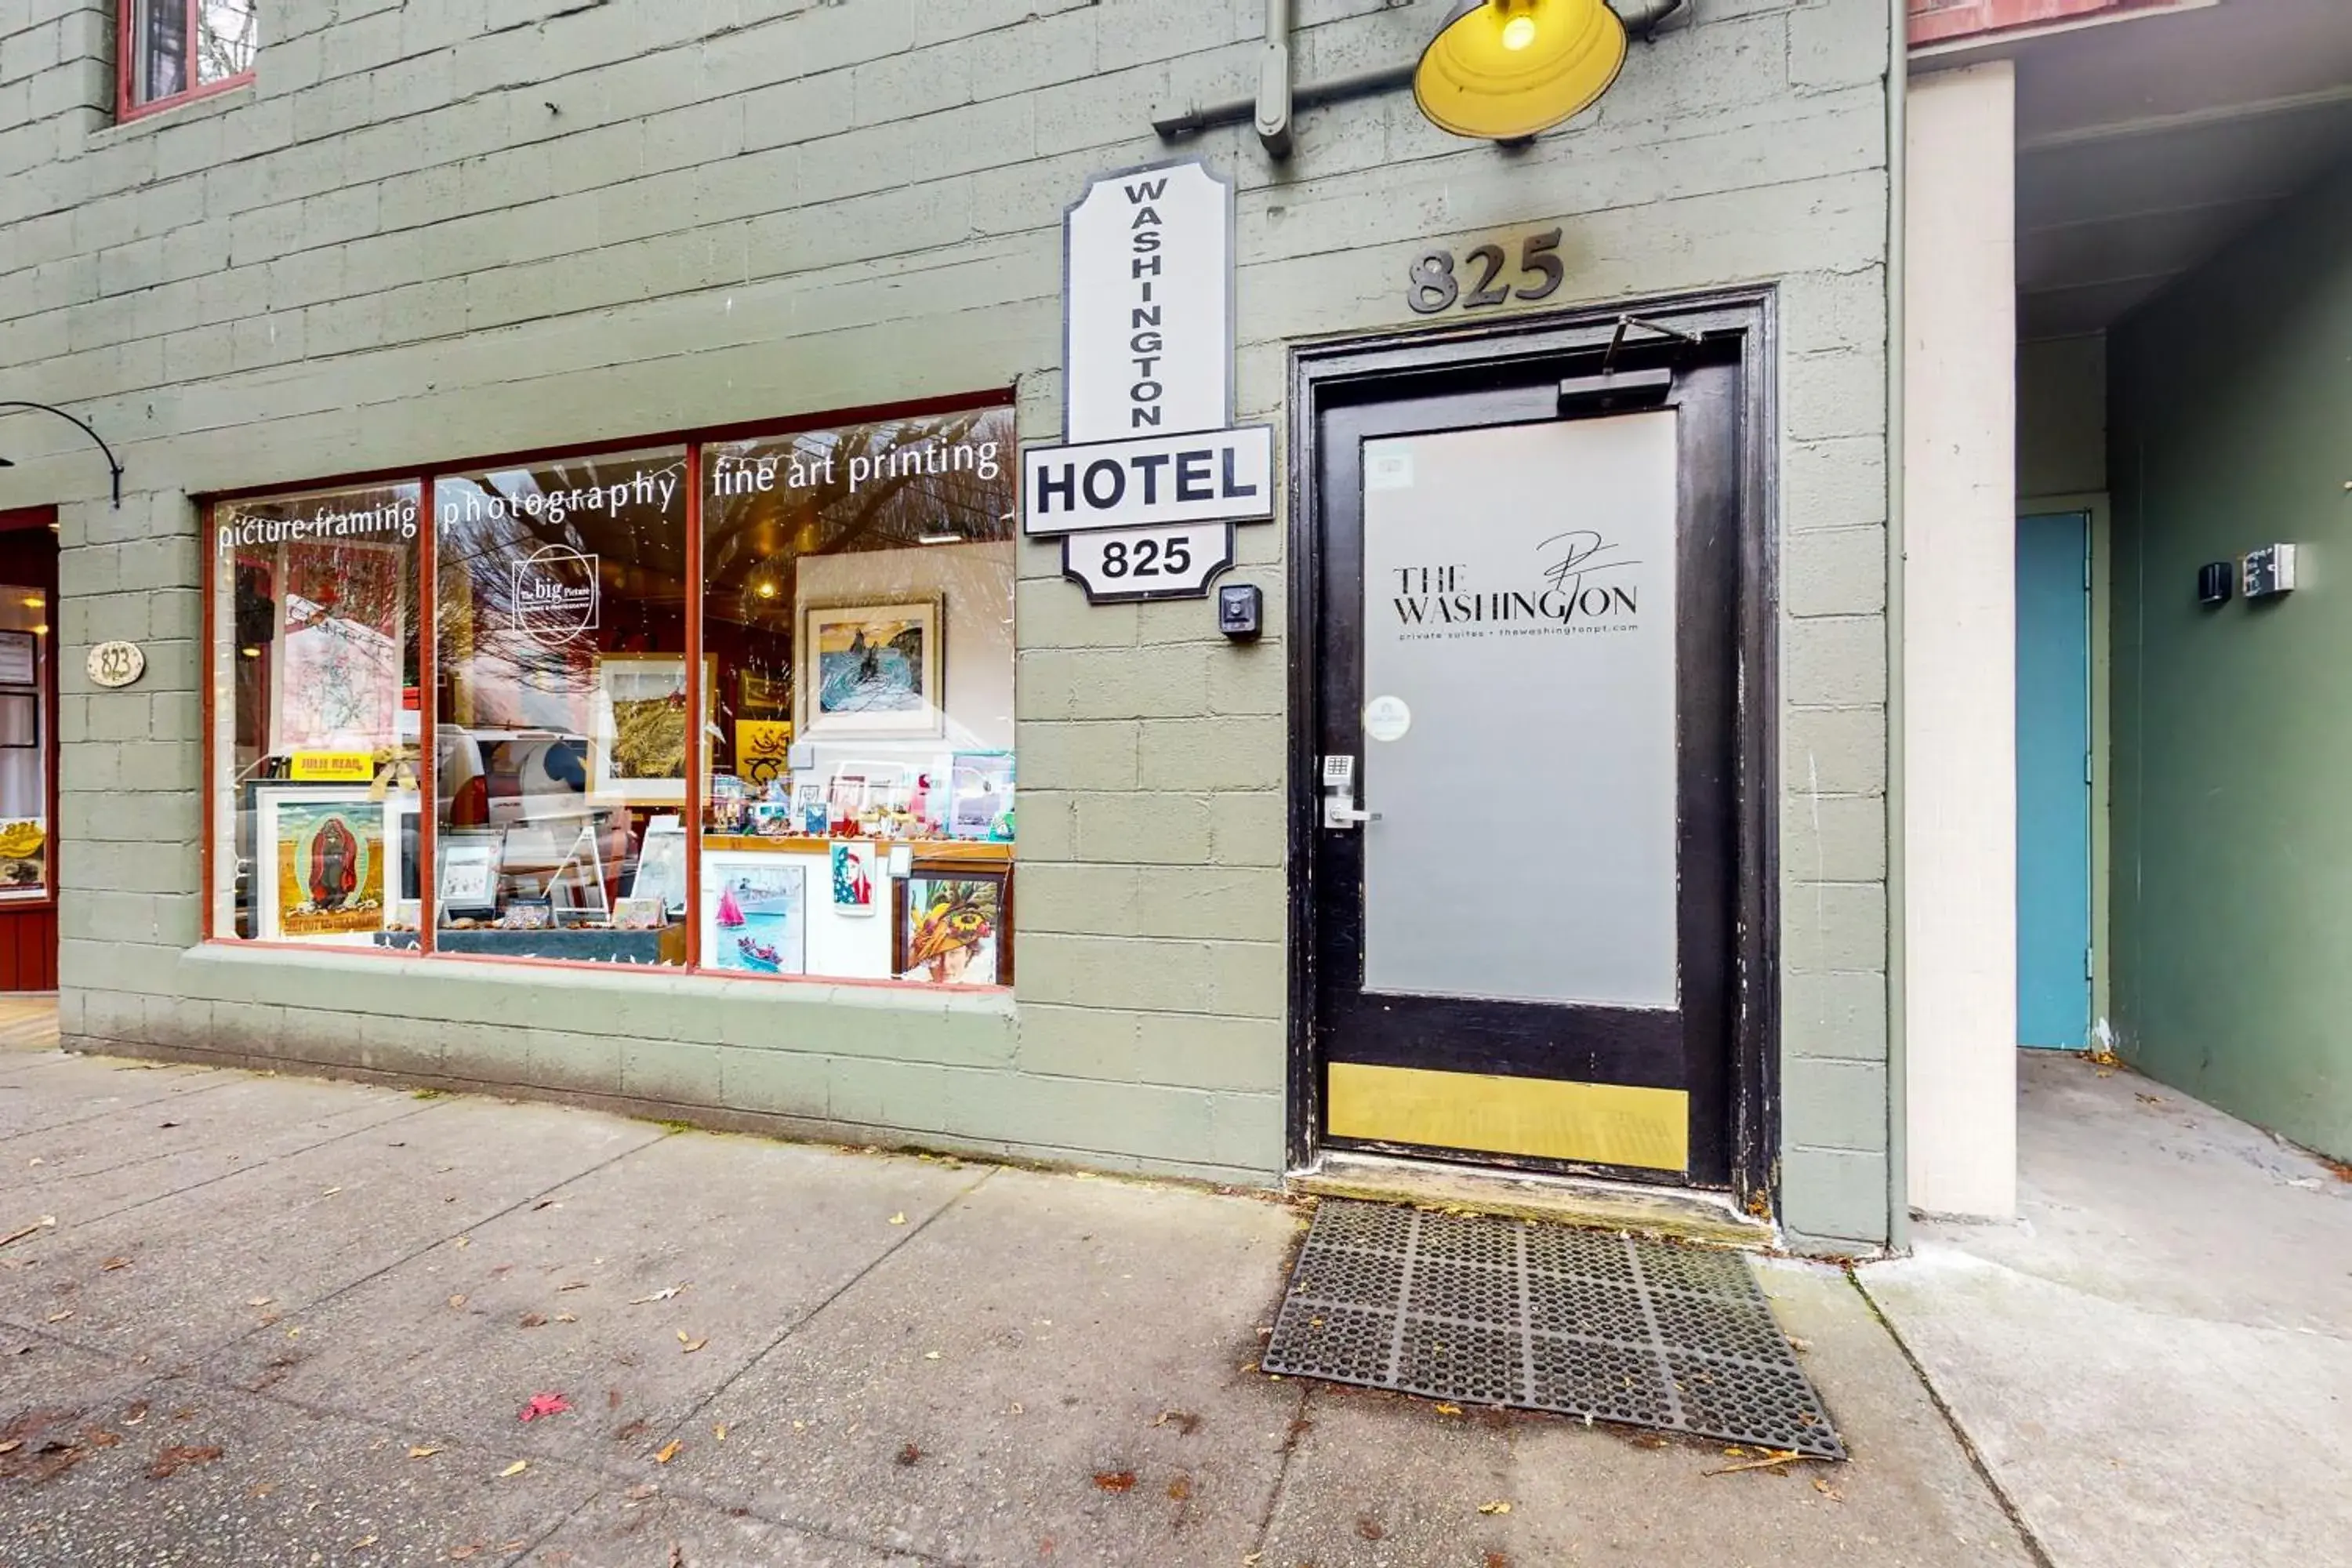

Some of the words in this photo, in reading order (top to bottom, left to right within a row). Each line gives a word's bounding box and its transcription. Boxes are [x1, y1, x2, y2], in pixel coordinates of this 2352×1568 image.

[1408, 227, 1564, 314] 825
[1124, 178, 1168, 428] WASHINGTON
[713, 461, 775, 496] fine
[789, 455, 835, 488] art
[849, 437, 999, 493] printing
[1037, 448, 1257, 514] HOTEL
[444, 470, 677, 534] photography
[220, 521, 306, 556] picture
[315, 503, 418, 538] framing
[1102, 536, 1192, 579] 825
[1393, 564, 1467, 594] THE
[535, 578, 563, 604] big
[1393, 586, 1637, 625] WASHINGTON
[1399, 630, 1442, 641] private
[1447, 630, 1485, 639] suites
[1499, 624, 1639, 637] thewashingtonpt.com
[101, 648, 131, 678] 823
